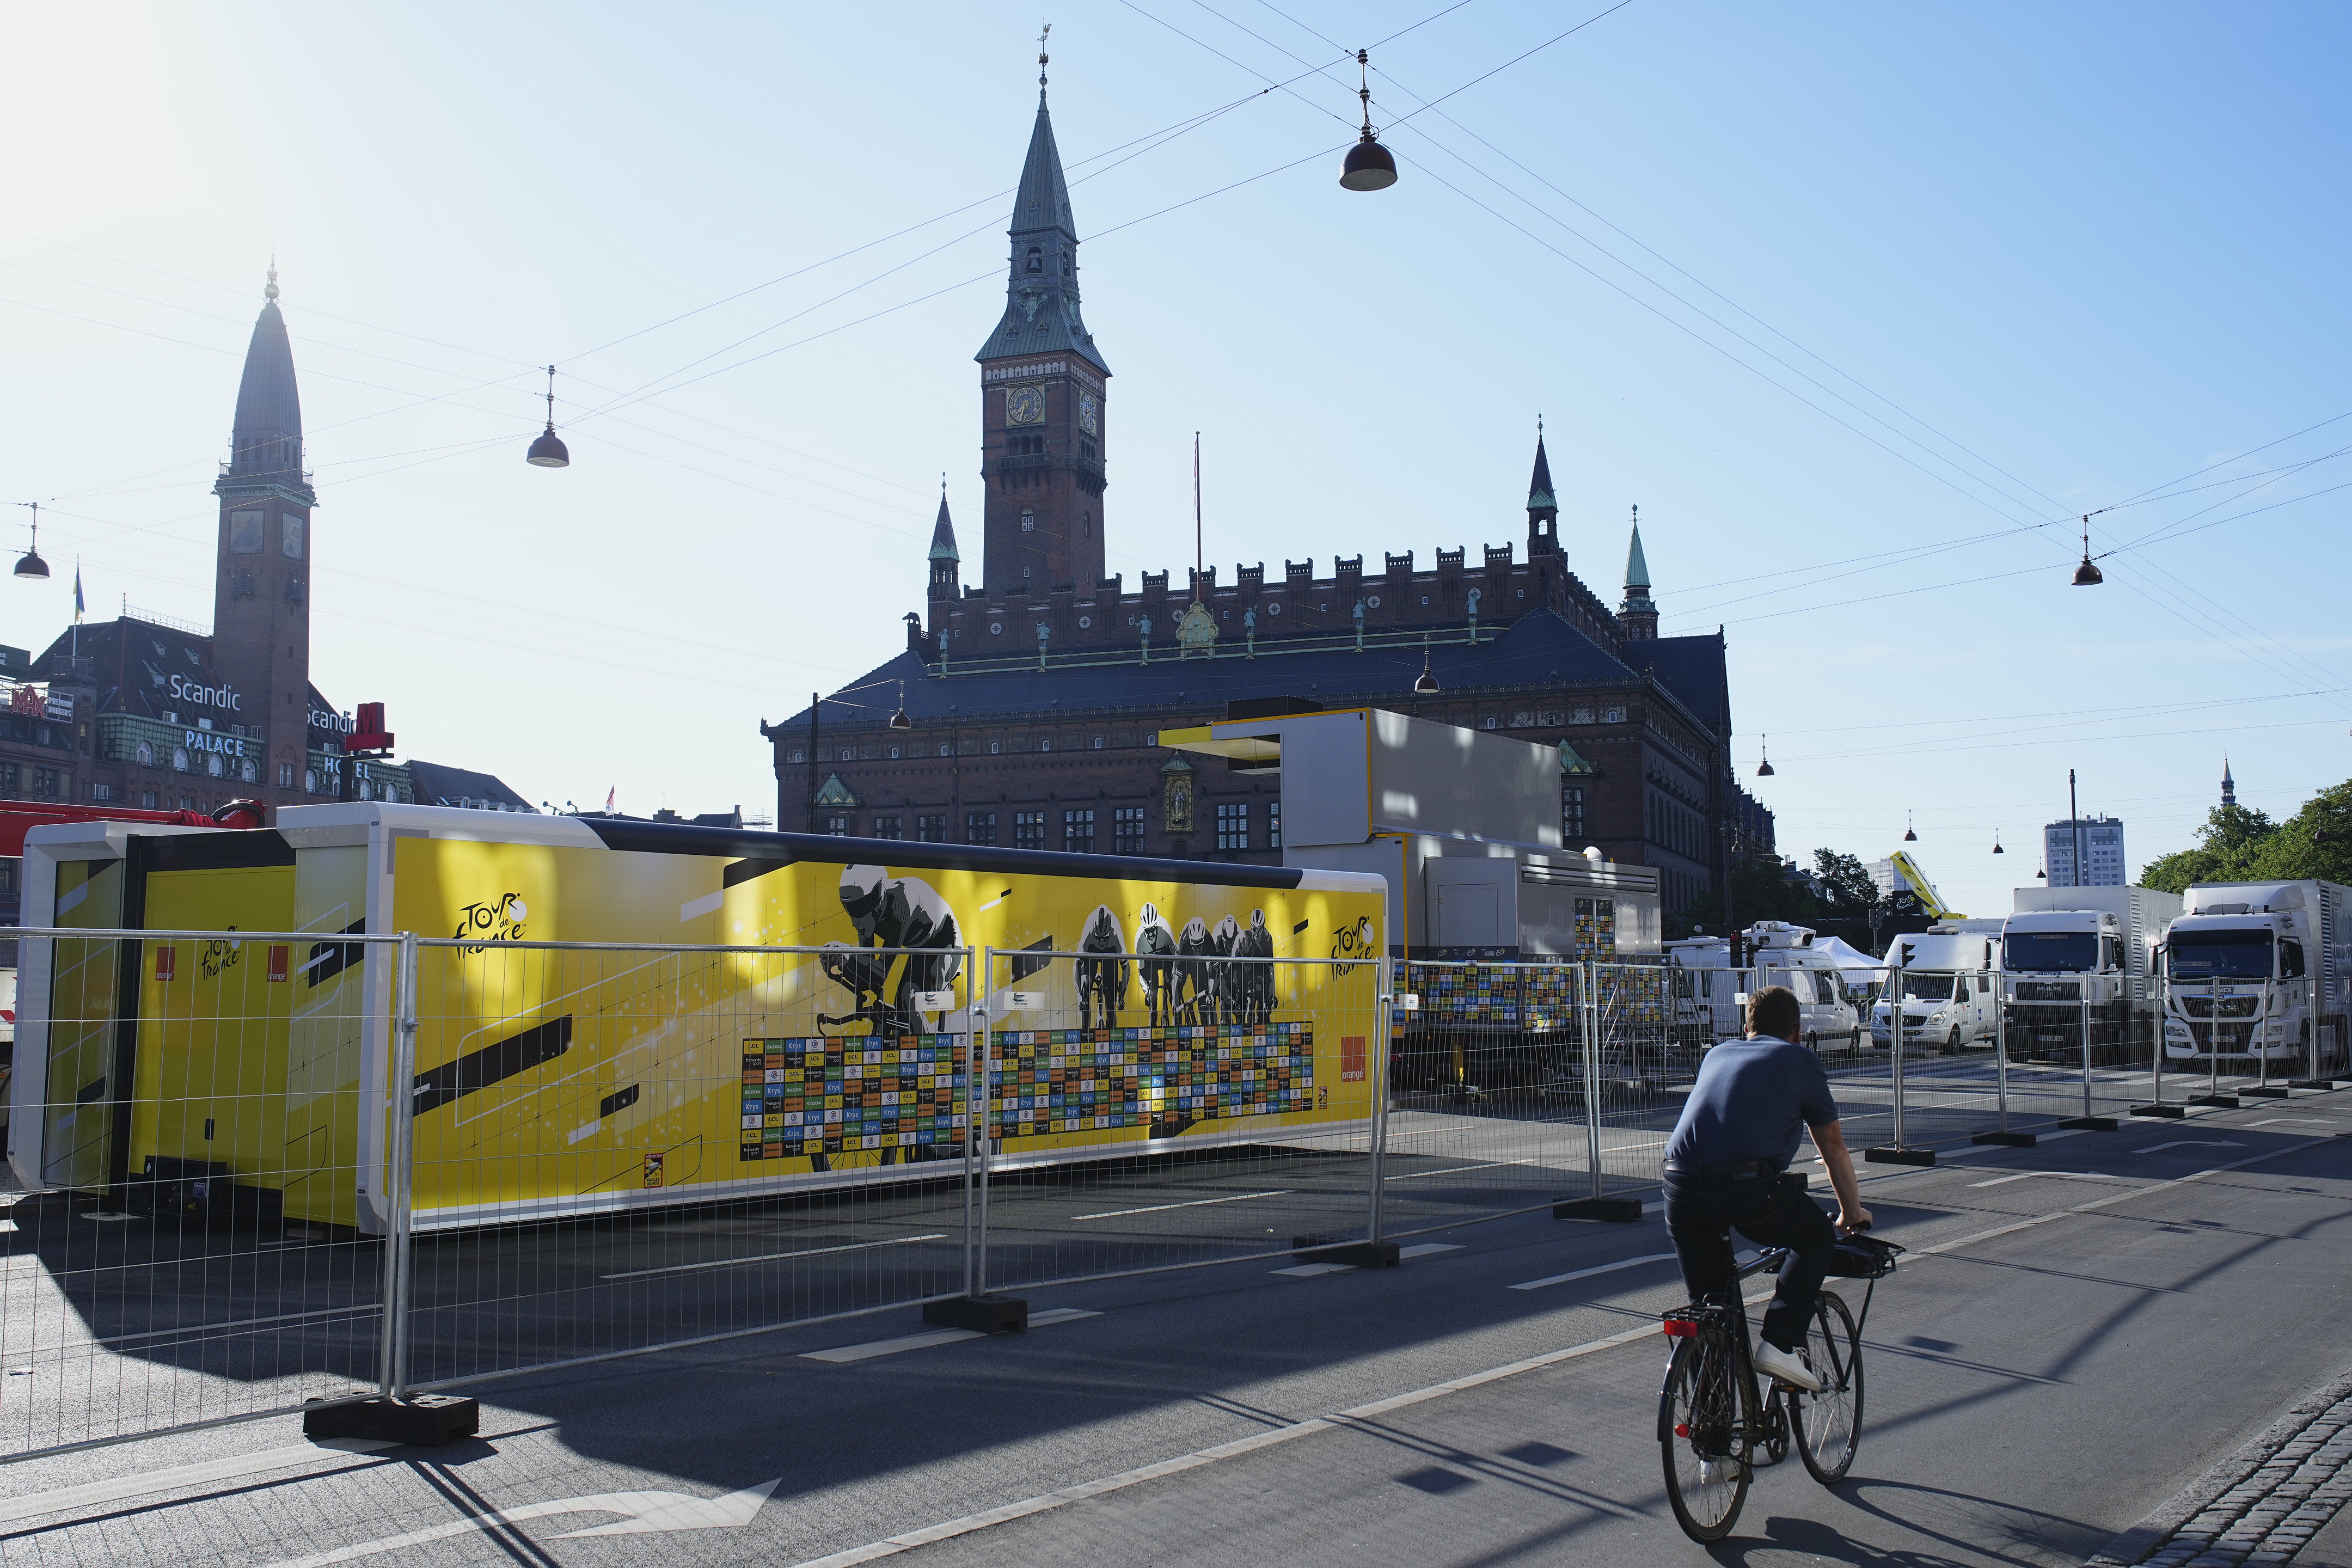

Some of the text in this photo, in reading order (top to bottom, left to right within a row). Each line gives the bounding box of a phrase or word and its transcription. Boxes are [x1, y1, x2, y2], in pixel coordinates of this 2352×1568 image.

[170, 675, 241, 711] Scandic
[13, 684, 47, 719] MAX
[48, 696, 72, 708] PREMIUM
[48, 706, 72, 717] BURGERS
[186, 730, 243, 757] PALACE
[325, 756, 370, 779] HEL
[500, 916, 510, 928] de
[1357, 939, 1363, 951] de
[156, 972, 173, 980] orange
[268, 972, 285, 981] orange
[789, 1043, 801, 1051] Krys
[1343, 1070, 1363, 1080] orange
